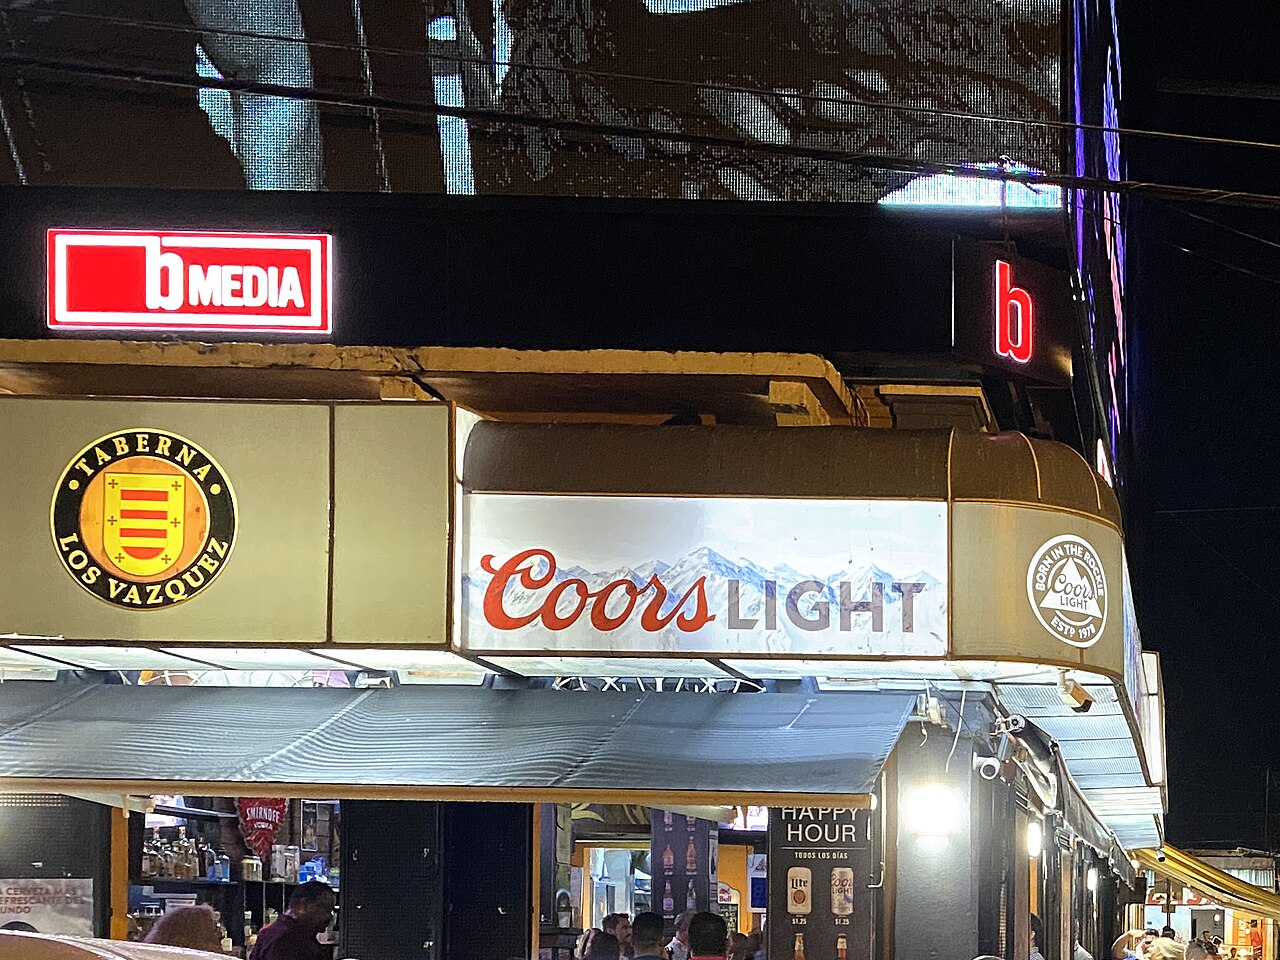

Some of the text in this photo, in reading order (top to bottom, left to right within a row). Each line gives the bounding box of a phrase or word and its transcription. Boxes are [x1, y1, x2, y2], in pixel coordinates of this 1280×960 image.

[188, 264, 305, 308] MEDIA
[995, 259, 1033, 363] b
[74, 433, 212, 482] TABERNA
[59, 532, 229, 605] LOS VAZQUEZ
[1035, 555, 1054, 592] BORN
[1050, 545, 1065, 560] IN
[1063, 544, 1084, 558] THE
[480, 548, 927, 633] Coors LIGHT
[1053, 573, 1095, 600] Coors
[1060, 595, 1088, 610] LIGHT
[246, 806, 280, 824] SMIRNOFF
[781, 807, 858, 820] HAPPY
[787, 823, 856, 842] HOUR
[832, 851, 848, 859] DÍAS
[791, 878, 808, 889] Lite
